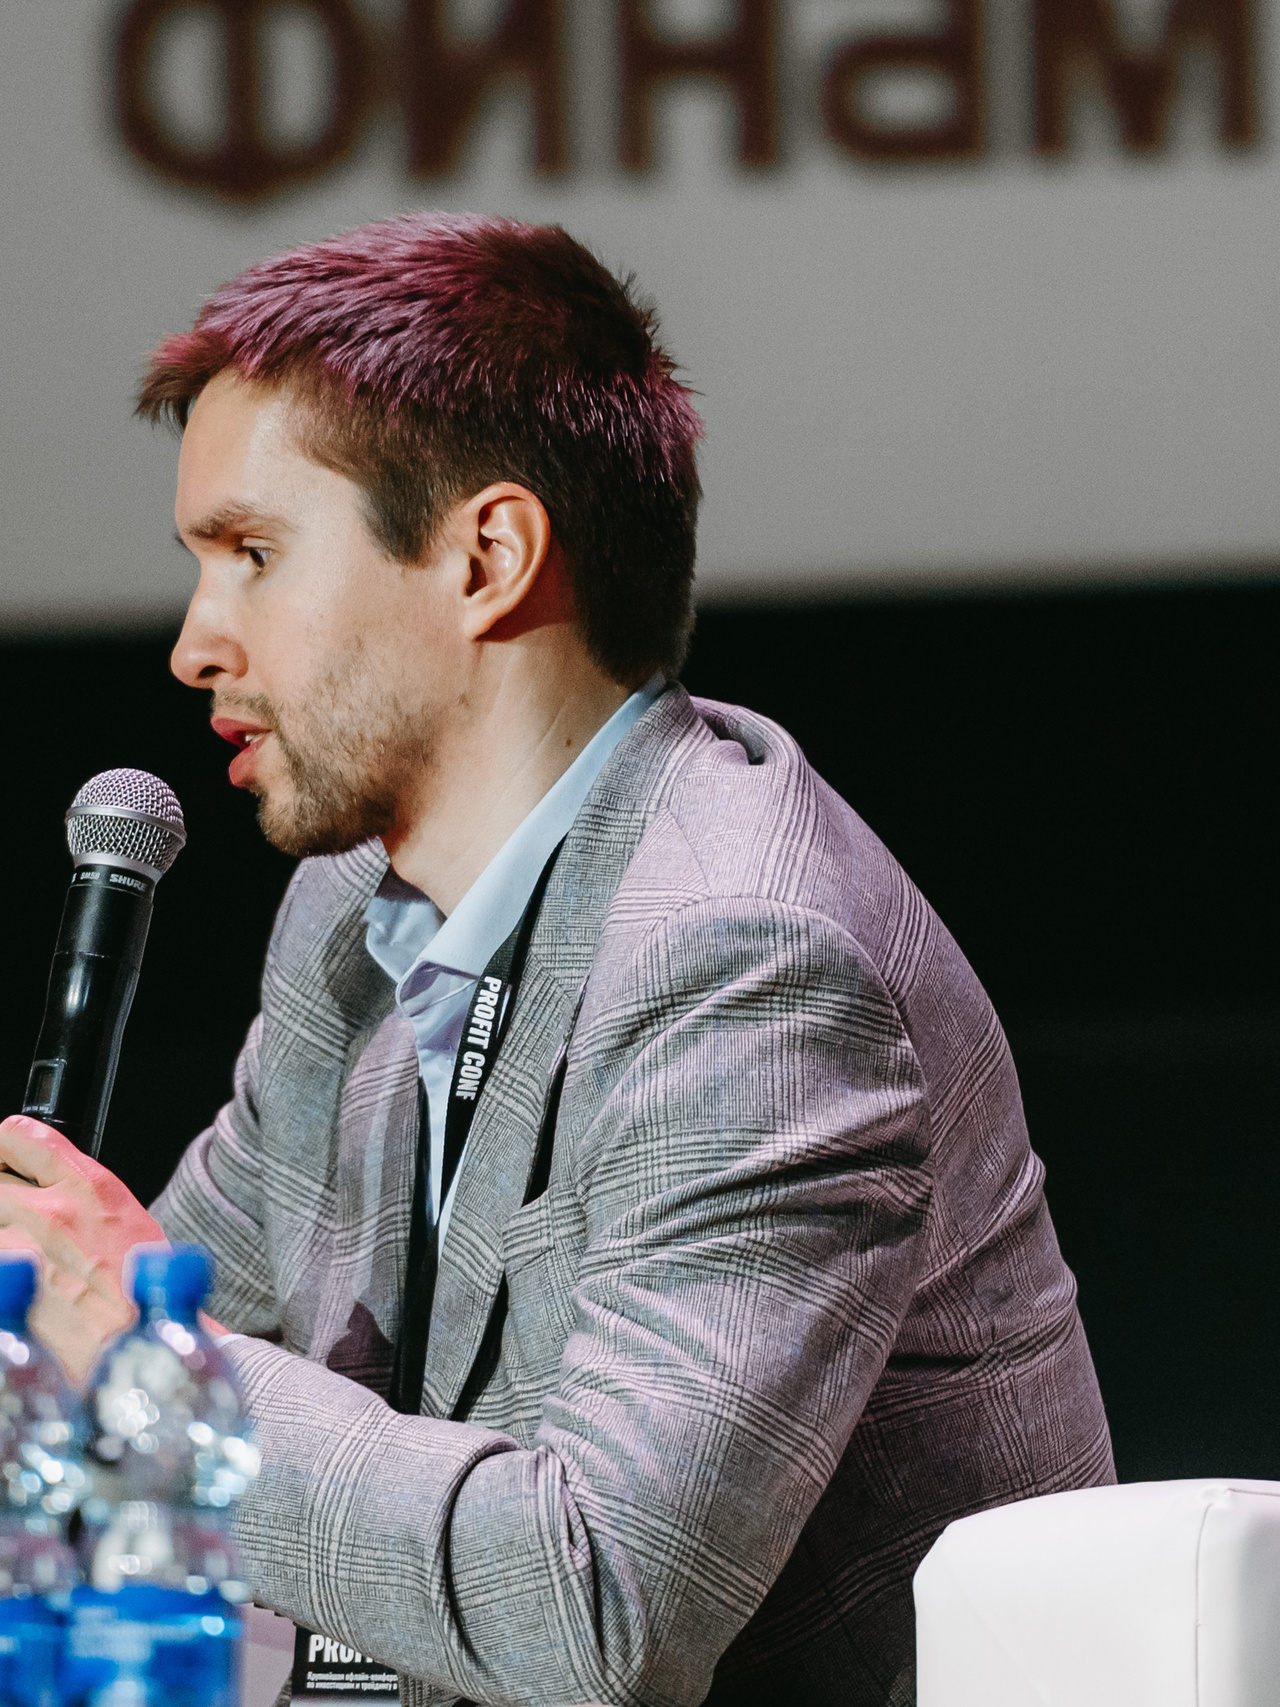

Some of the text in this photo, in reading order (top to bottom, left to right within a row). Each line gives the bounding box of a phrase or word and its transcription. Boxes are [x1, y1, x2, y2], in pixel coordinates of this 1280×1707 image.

[109, 873, 147, 892] SHURE
[455, 976, 502, 1101] PROFIT CONF
